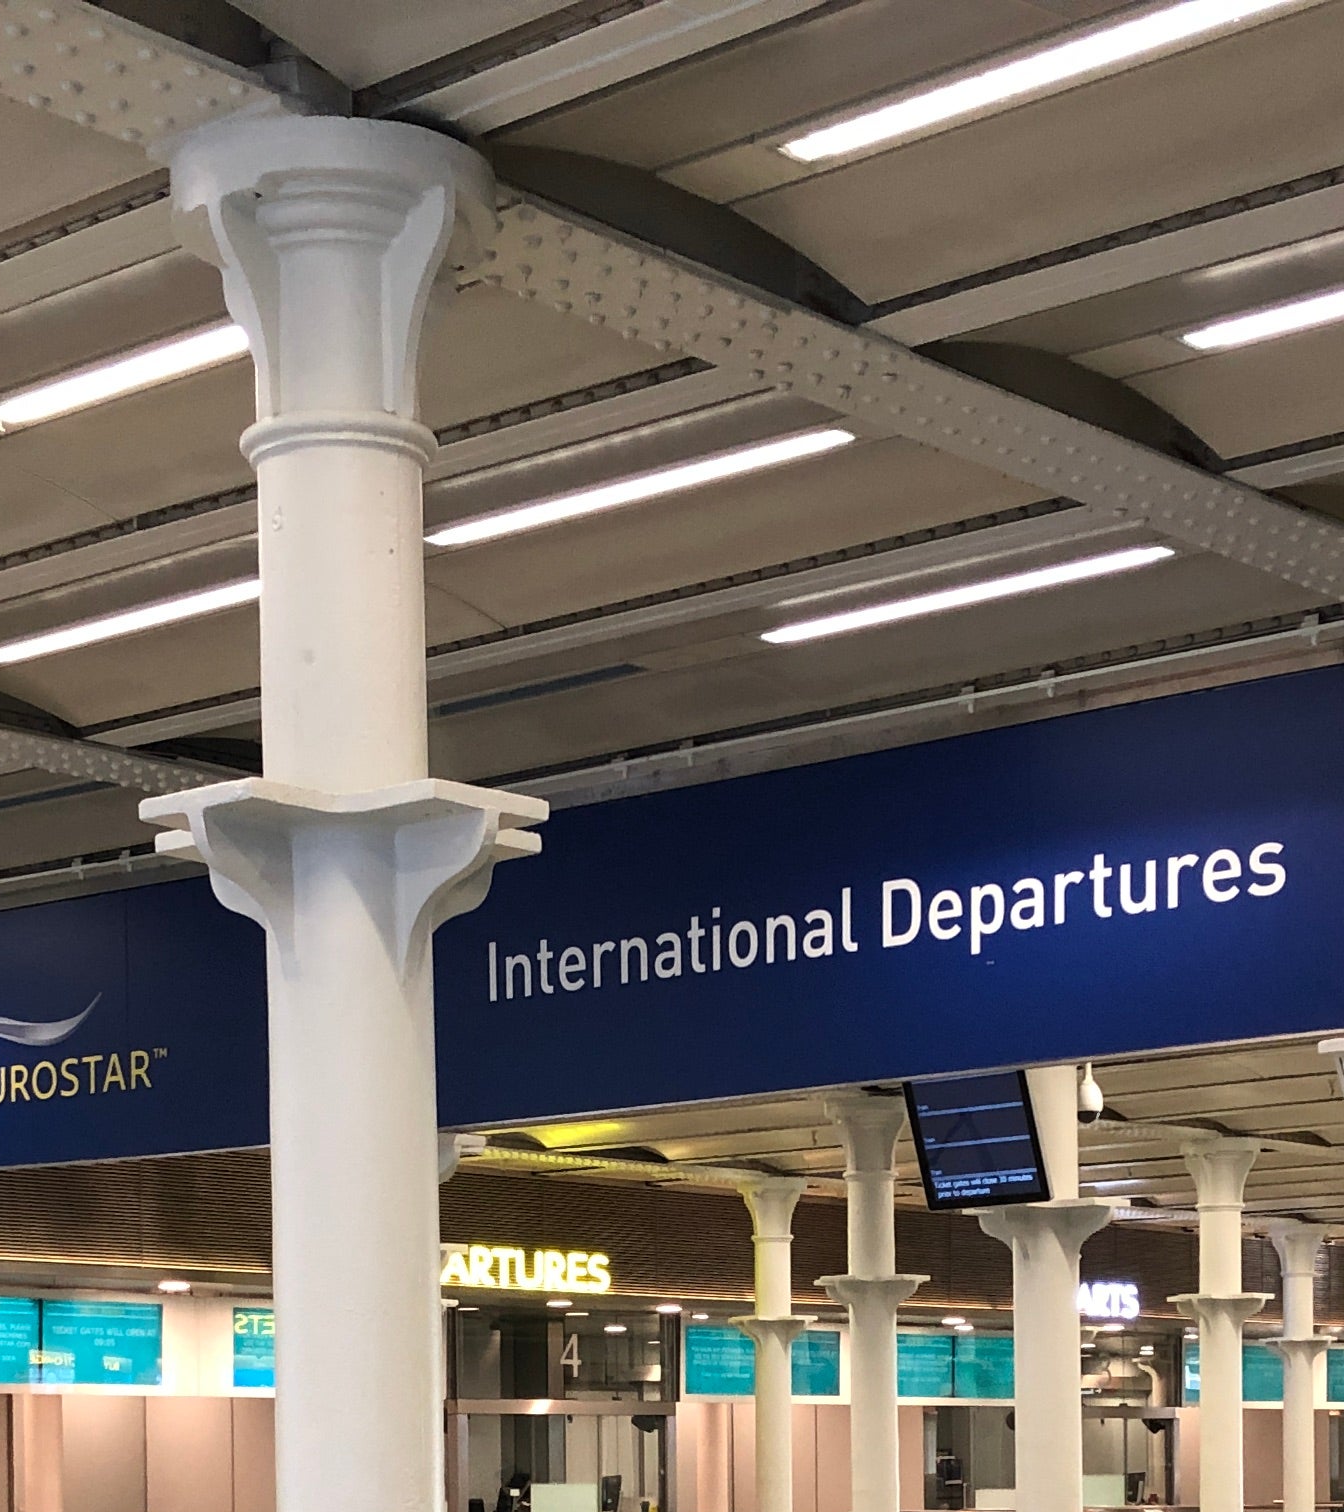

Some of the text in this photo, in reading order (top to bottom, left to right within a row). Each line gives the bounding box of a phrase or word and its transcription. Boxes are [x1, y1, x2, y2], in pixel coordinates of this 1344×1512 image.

[488, 841, 1287, 1002] International Departures
[559, 1333, 582, 1378] 4
